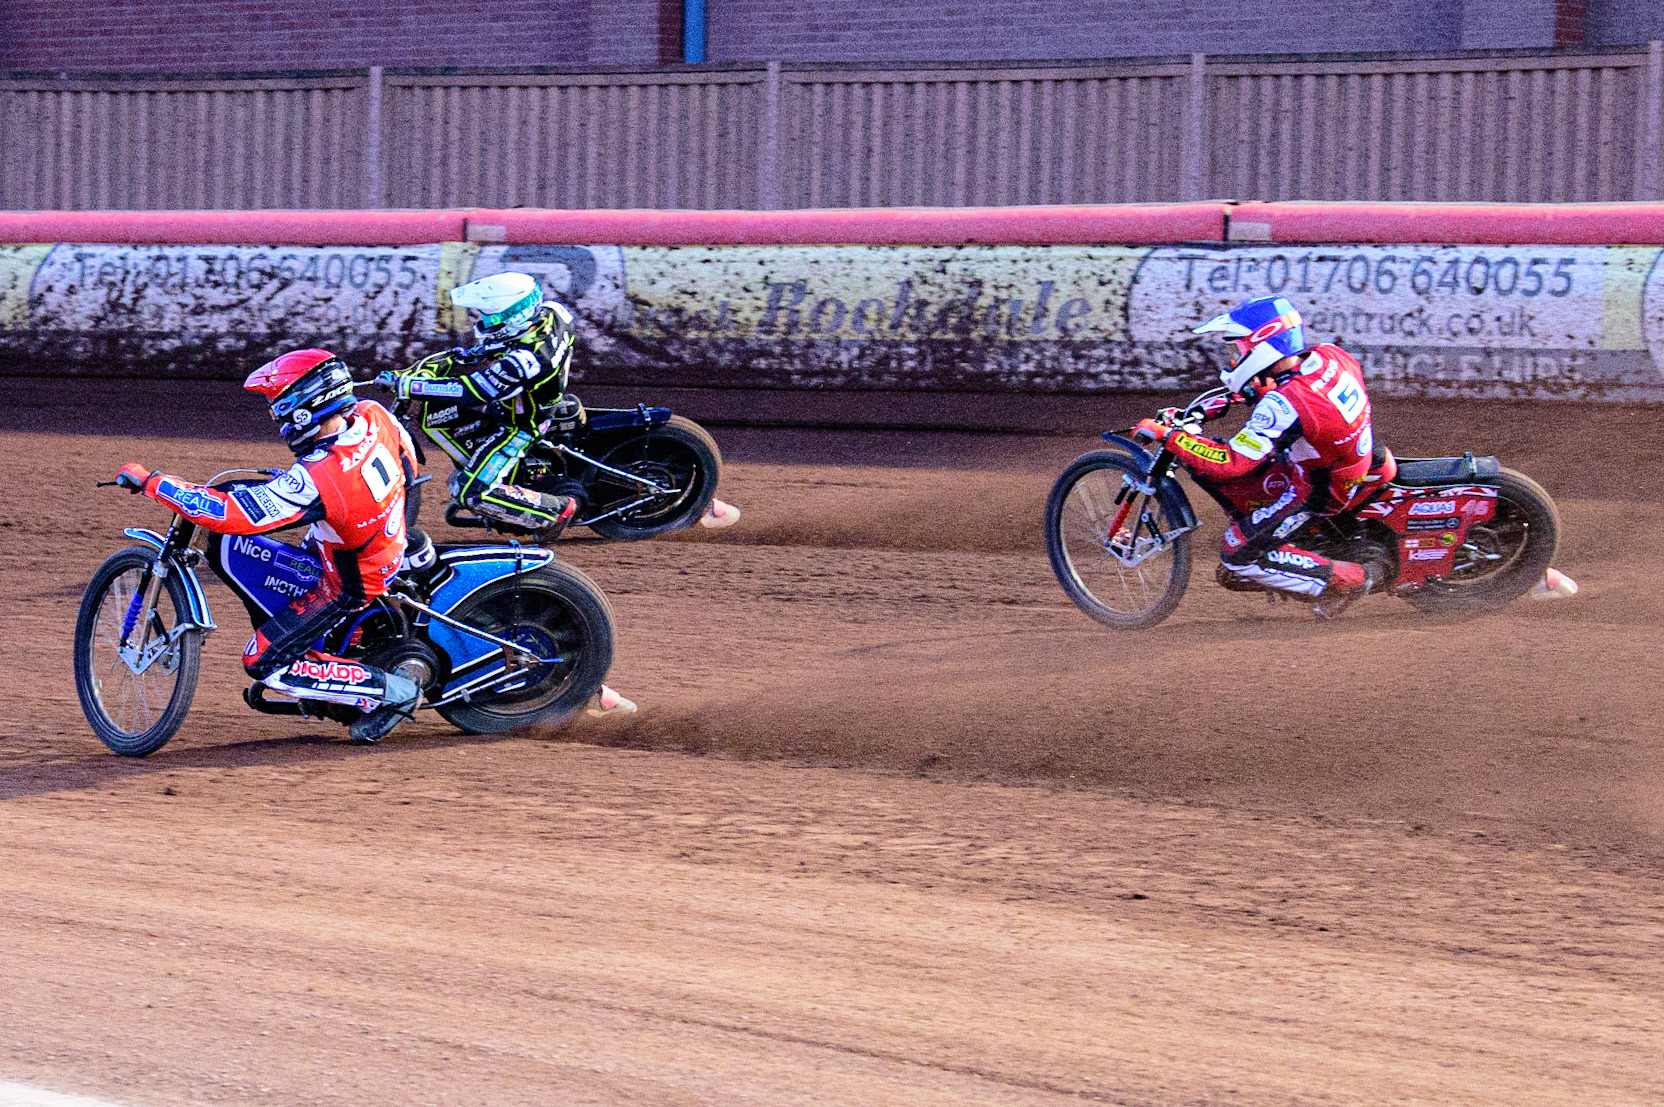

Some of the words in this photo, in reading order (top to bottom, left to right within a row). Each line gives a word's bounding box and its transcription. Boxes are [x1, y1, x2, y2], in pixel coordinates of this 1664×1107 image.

[1266, 254, 1397, 295] 01706
[1411, 254, 1577, 297] 640055
[1337, 383, 1359, 412] 5
[371, 457, 391, 487] 1
[173, 488, 212, 513] REALL
[233, 535, 272, 562] Nice
[263, 575, 309, 598] INOTH
